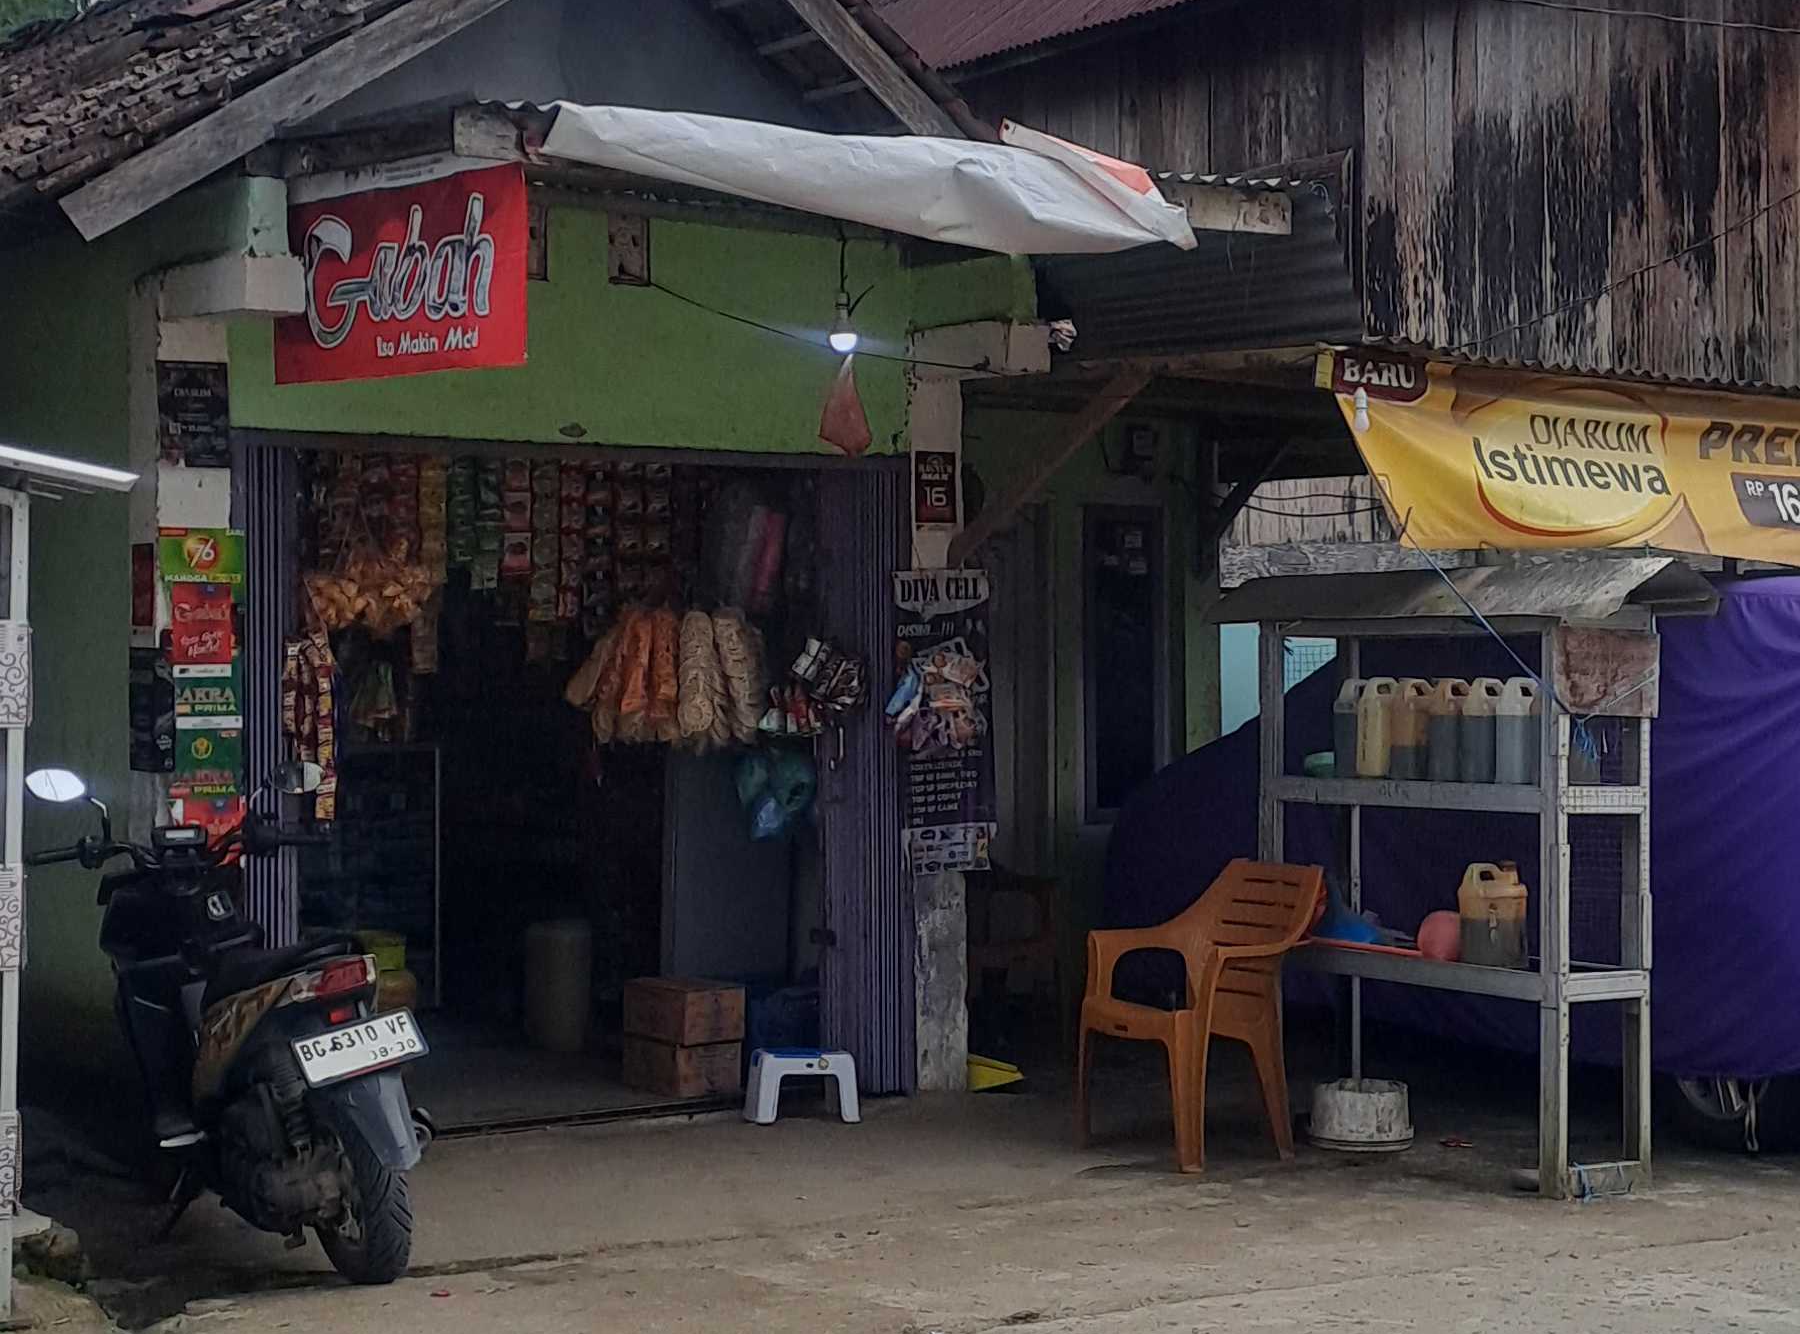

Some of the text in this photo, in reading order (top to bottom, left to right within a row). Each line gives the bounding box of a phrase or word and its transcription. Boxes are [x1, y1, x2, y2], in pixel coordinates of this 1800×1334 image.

[304, 191, 495, 349] Gabah
[396, 330, 439, 356] Makin
[1343, 357, 1416, 389] BARU
[1529, 413, 1653, 454] DJARUM
[1700, 421, 1800, 467] PRE
[1472, 436, 1672, 496] Istimewa
[924, 486, 947, 507] 16
[1745, 479, 1765, 496] RP
[190, 538, 215, 567] 76
[900, 576, 982, 602] DIVA CELL
[194, 703, 237, 714] PRIMA
[331, 1025, 378, 1052] 6310
[385, 1015, 407, 1035] VF
